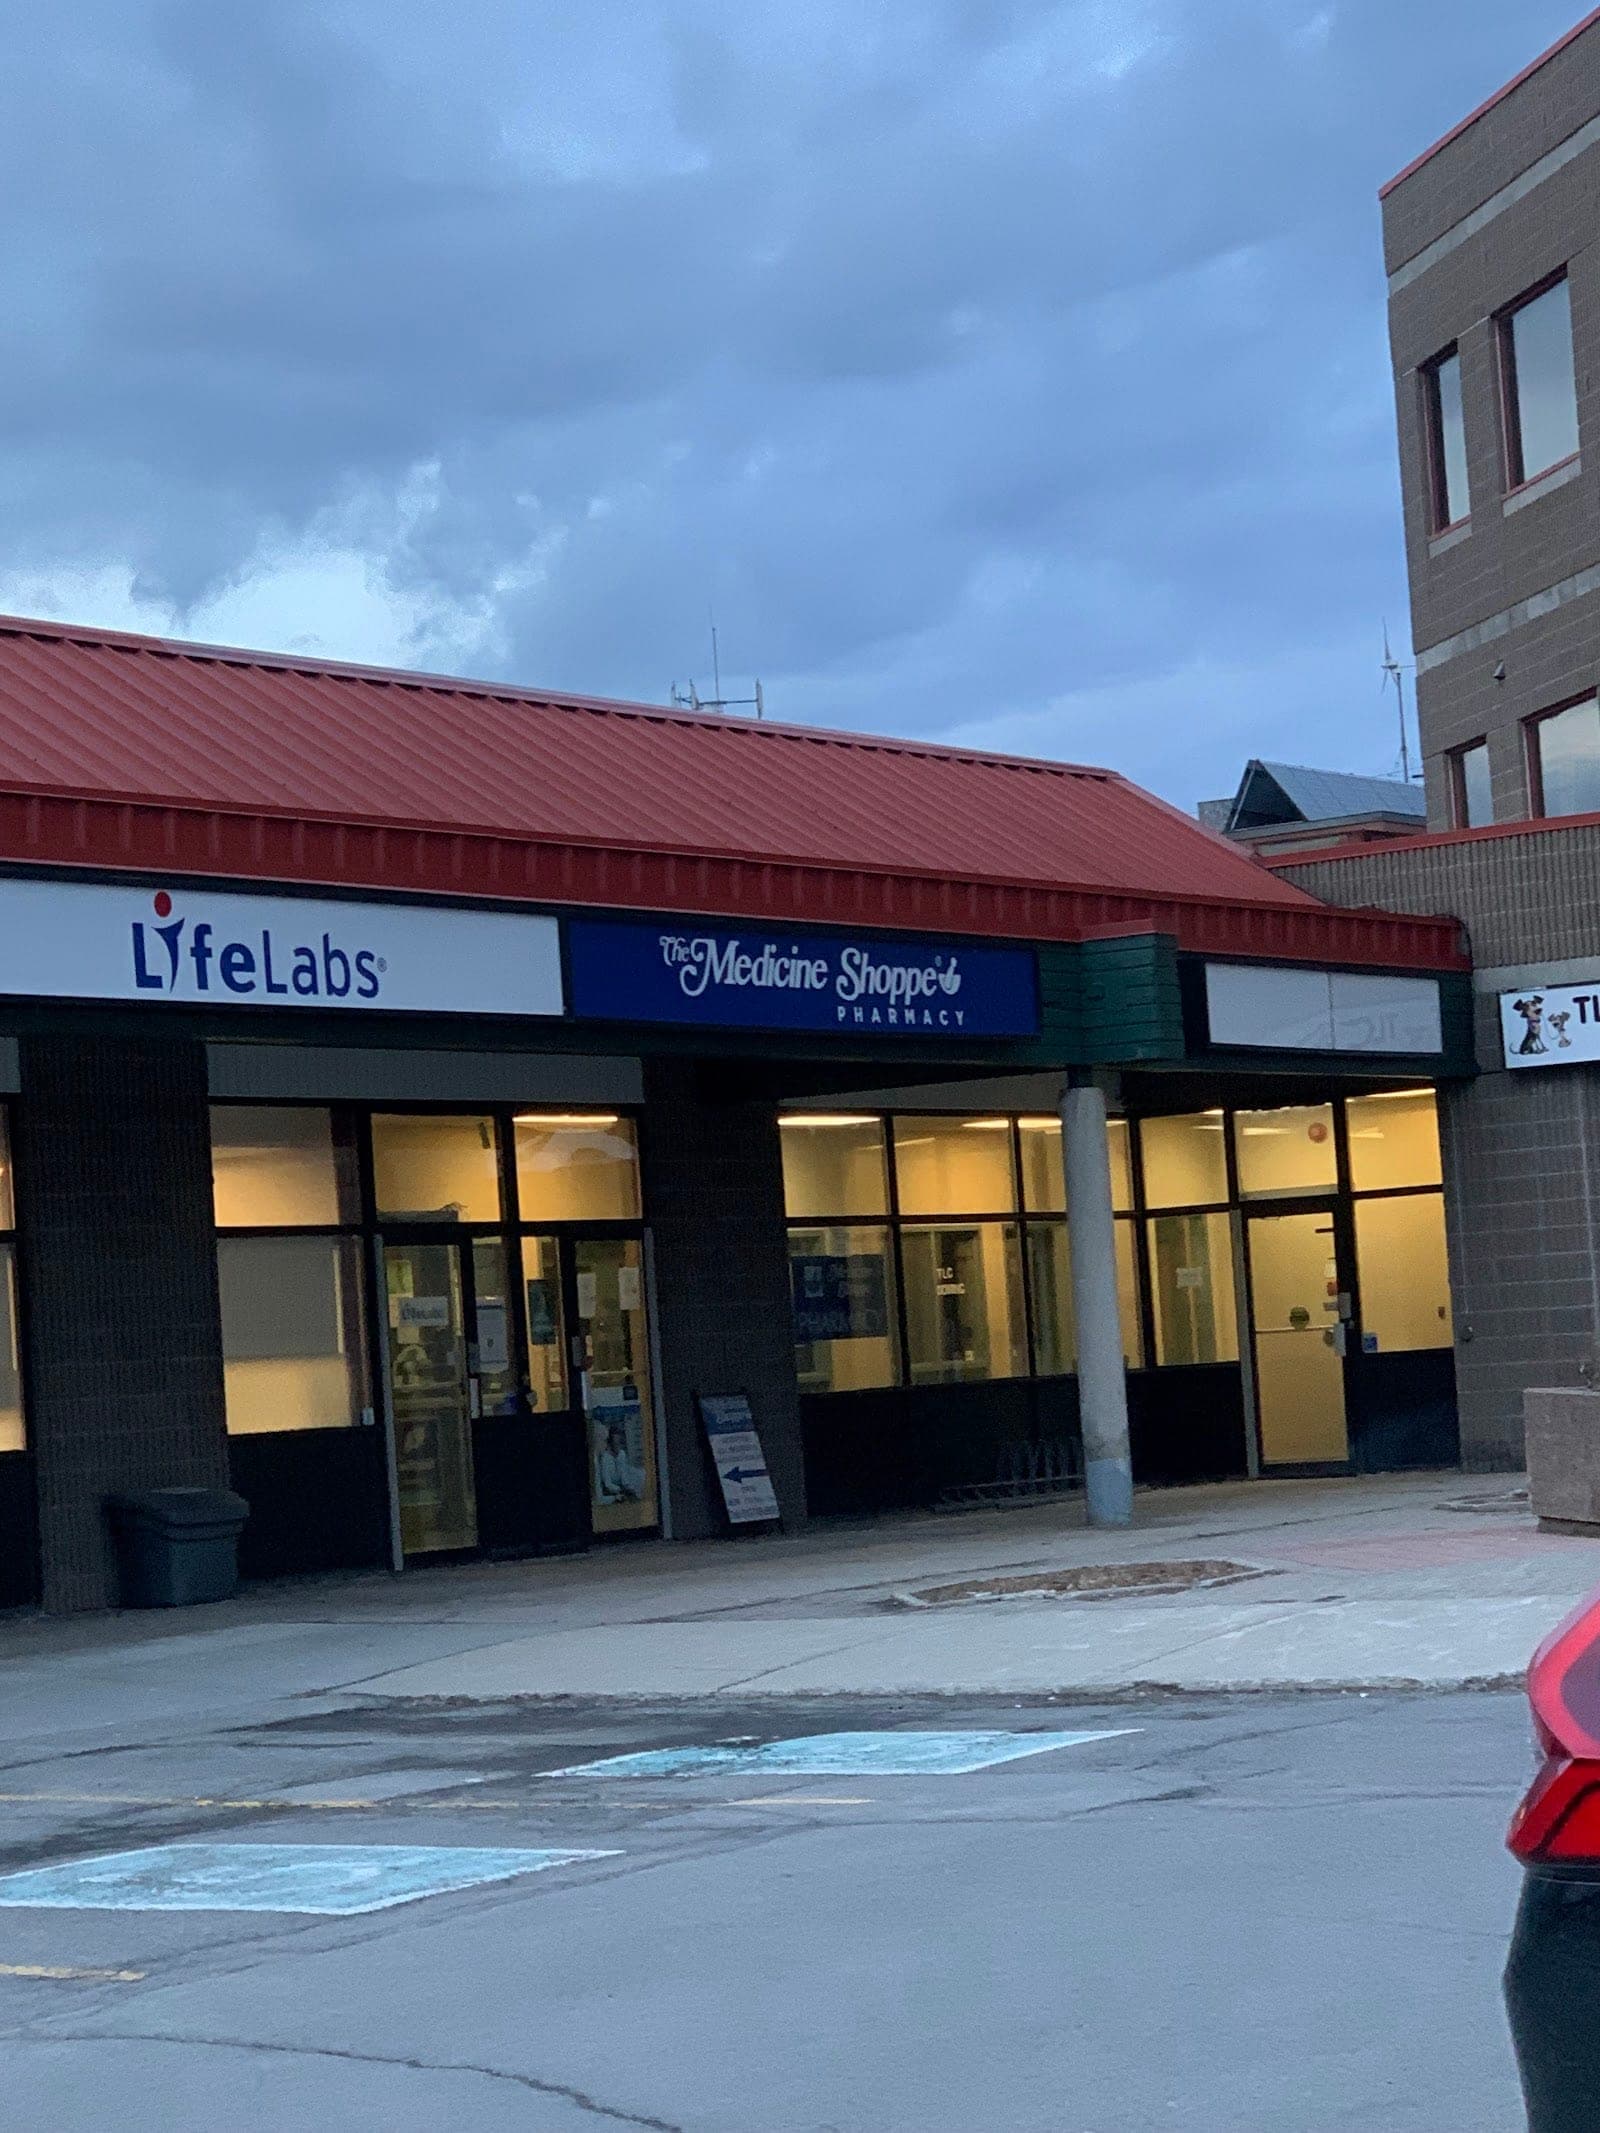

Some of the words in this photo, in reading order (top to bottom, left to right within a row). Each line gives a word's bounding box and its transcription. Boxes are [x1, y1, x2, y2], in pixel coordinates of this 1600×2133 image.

[132, 891, 380, 998] LifeLabs
[659, 935, 689, 967] The
[679, 937, 828, 997] Medicine
[836, 947, 938, 1005] Shoppe
[837, 1006, 965, 1026] PHARMACY
